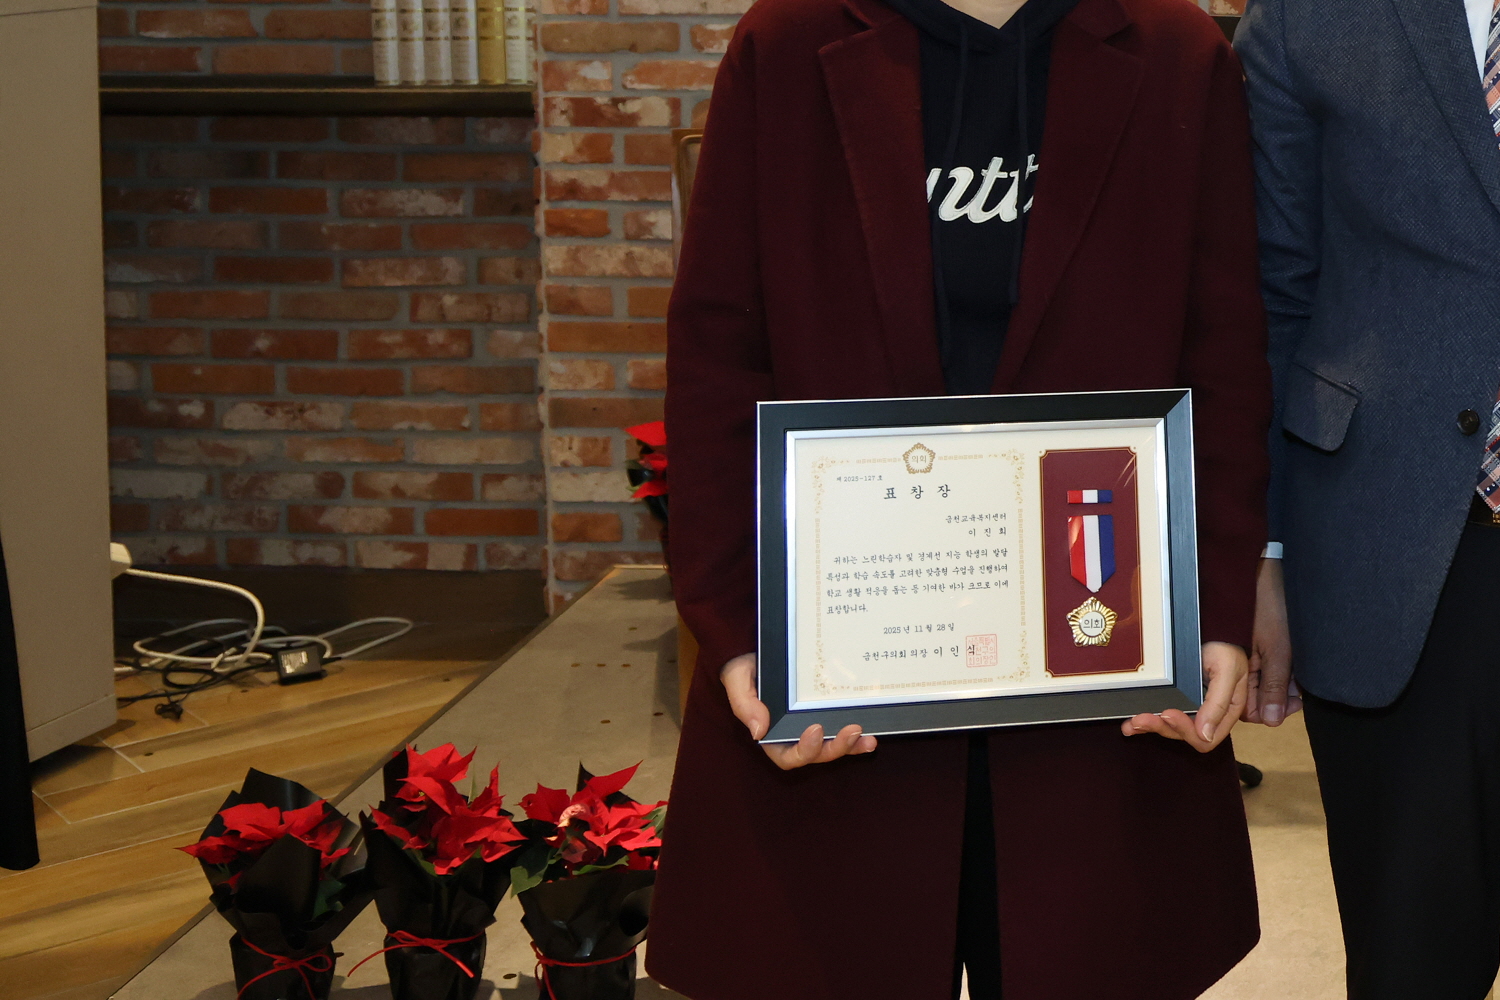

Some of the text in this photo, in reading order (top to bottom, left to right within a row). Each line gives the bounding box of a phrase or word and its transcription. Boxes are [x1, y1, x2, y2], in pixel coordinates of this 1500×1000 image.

[834, 556, 857, 564] 귀하는
[862, 553, 901, 563] 느린학습자
[906, 553, 913, 561] 및
[918, 552, 941, 561] 경계선
[946, 551, 961, 560] 지능
[966, 549, 988, 559] 학생의
[854, 571, 868, 580] 학습
[873, 570, 895, 579] 속도를
[900, 568, 922, 578] 고려한
[952, 565, 974, 575] 수업을
[979, 564, 1008, 575] 진행하여
[827, 589, 841, 598] 학교
[846, 588, 861, 597] 생활
[866, 586, 888, 596] 적응을
[911, 584, 919, 594] 등
[923, 584, 945, 592] 기여한
[950, 582, 964, 591] 바가
[968, 581, 990, 590] 크므로
[994, 580, 1009, 588] 이에
[827, 604, 868, 615] 표창합니다.
[915, 625, 922, 633] 11
[1083, 618, 1102, 628] 의회
[863, 651, 906, 661] 금천구의회
[911, 649, 927, 659] 의장
